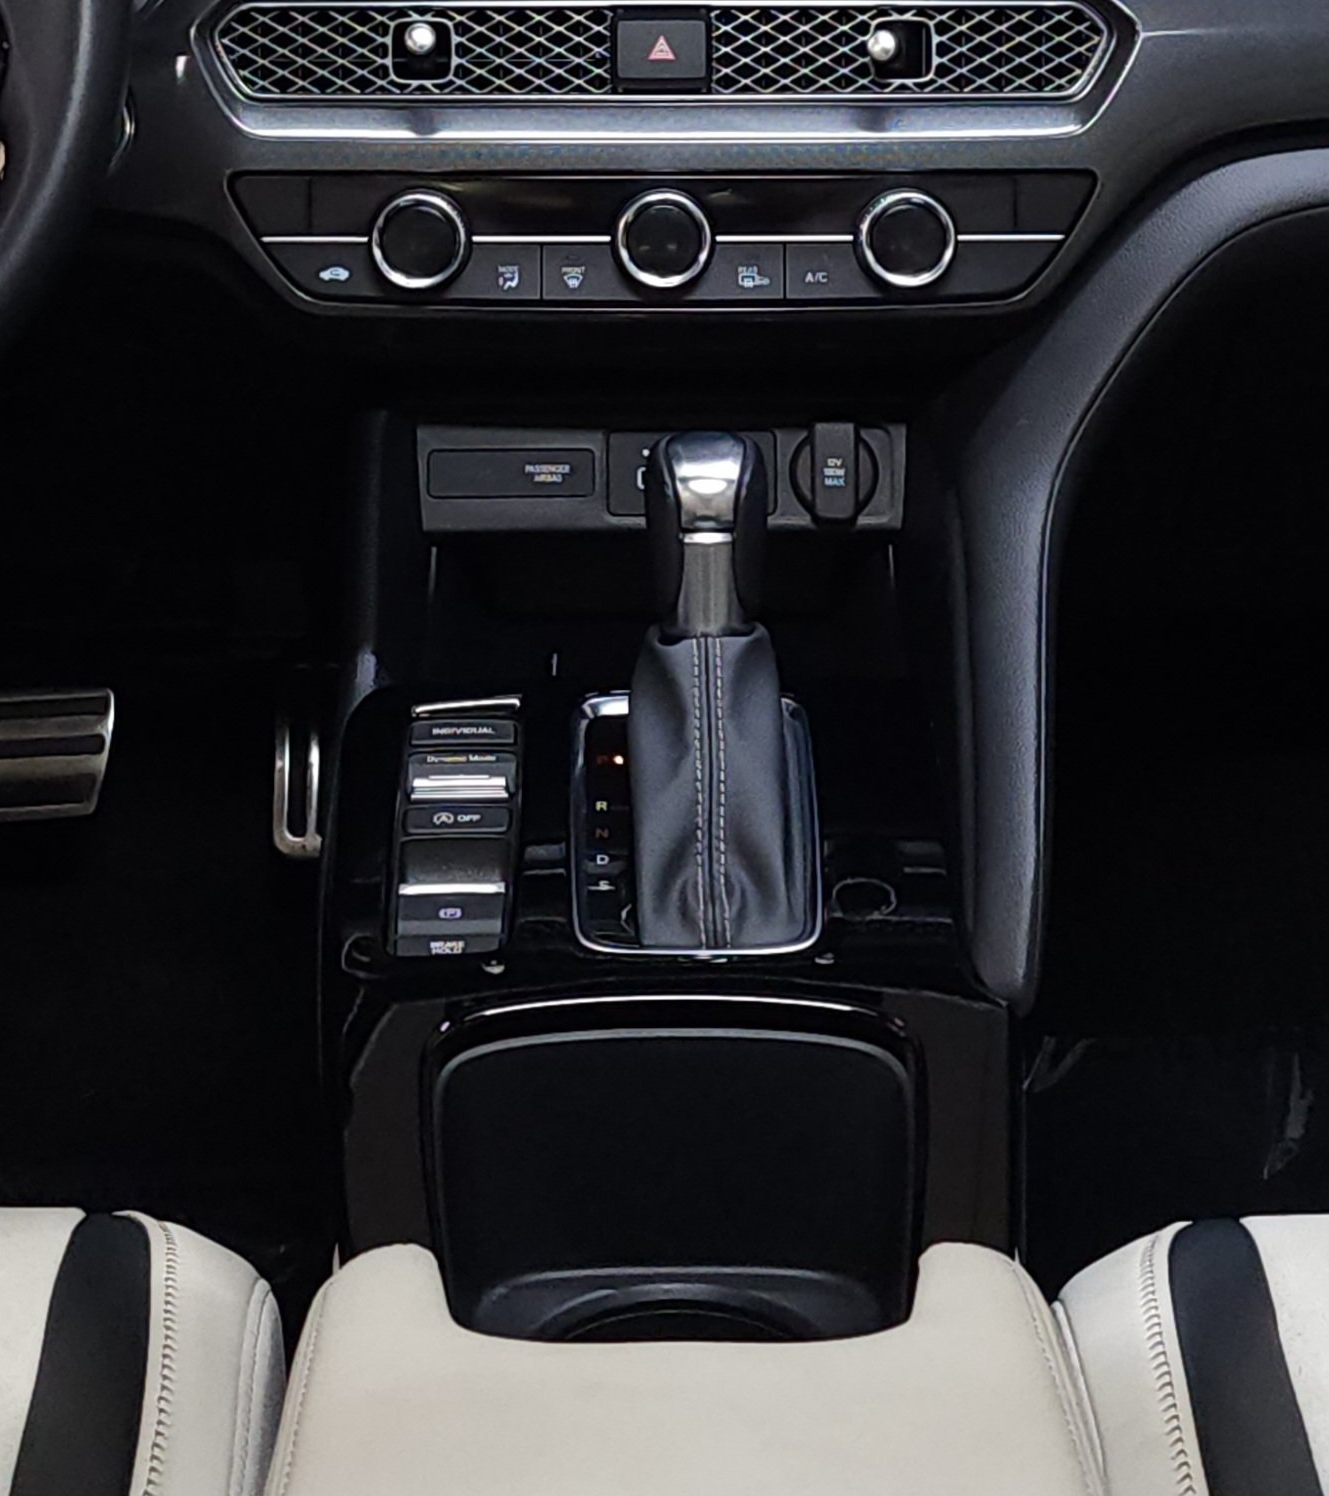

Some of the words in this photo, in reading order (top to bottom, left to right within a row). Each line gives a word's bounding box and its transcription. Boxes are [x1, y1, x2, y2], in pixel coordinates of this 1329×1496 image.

[804, 272, 829, 283] A/C
[825, 477, 846, 487] MAX
[432, 727, 495, 735] INDIVIDUAL
[427, 754, 467, 763] Dynamic
[595, 801, 607, 811] R
[457, 814, 482, 822] OFF
[595, 828, 608, 838] N
[596, 855, 610, 865] D
